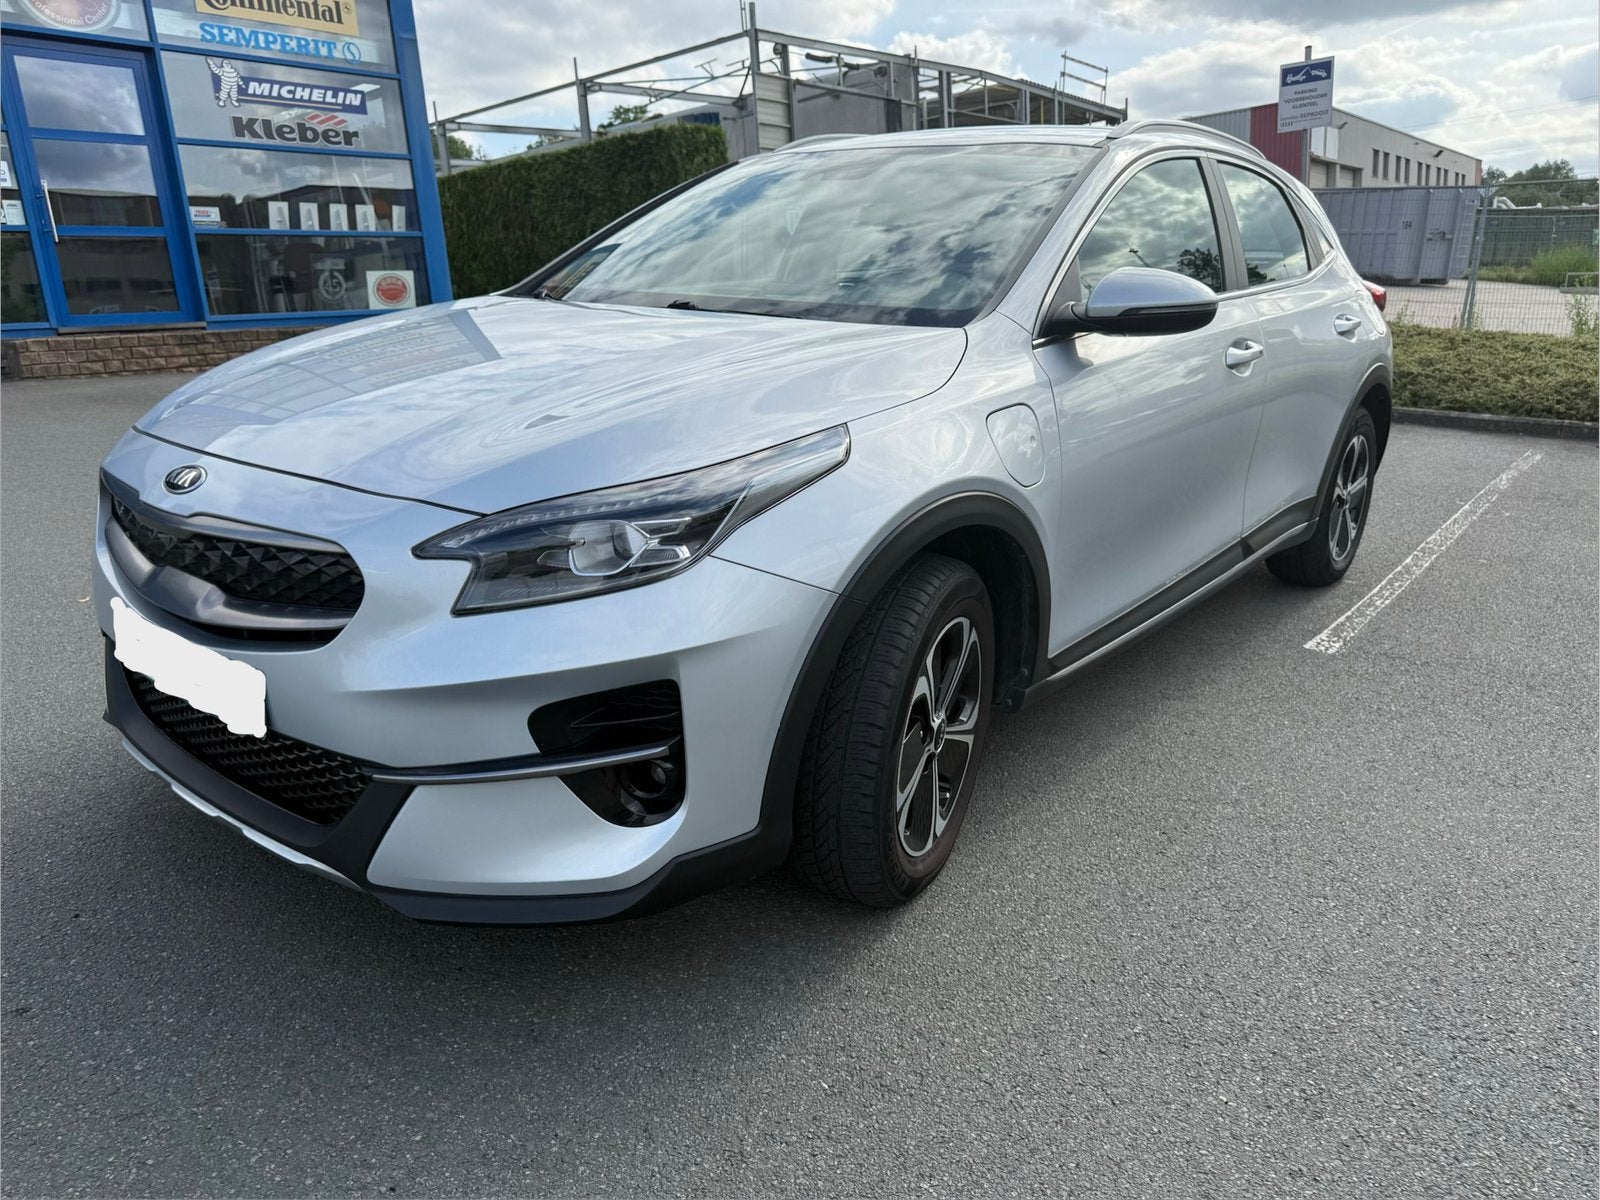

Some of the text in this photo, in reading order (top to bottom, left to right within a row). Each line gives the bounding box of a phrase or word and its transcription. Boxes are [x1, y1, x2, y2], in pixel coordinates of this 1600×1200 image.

[32, 0, 84, 25] ofessional
[203, 0, 344, 24] nental
[199, 22, 337, 59] SEMPERIT
[247, 81, 362, 106] MICHELIN
[1292, 101, 1318, 109] KLIENTEEL
[232, 116, 359, 146] Kleber
